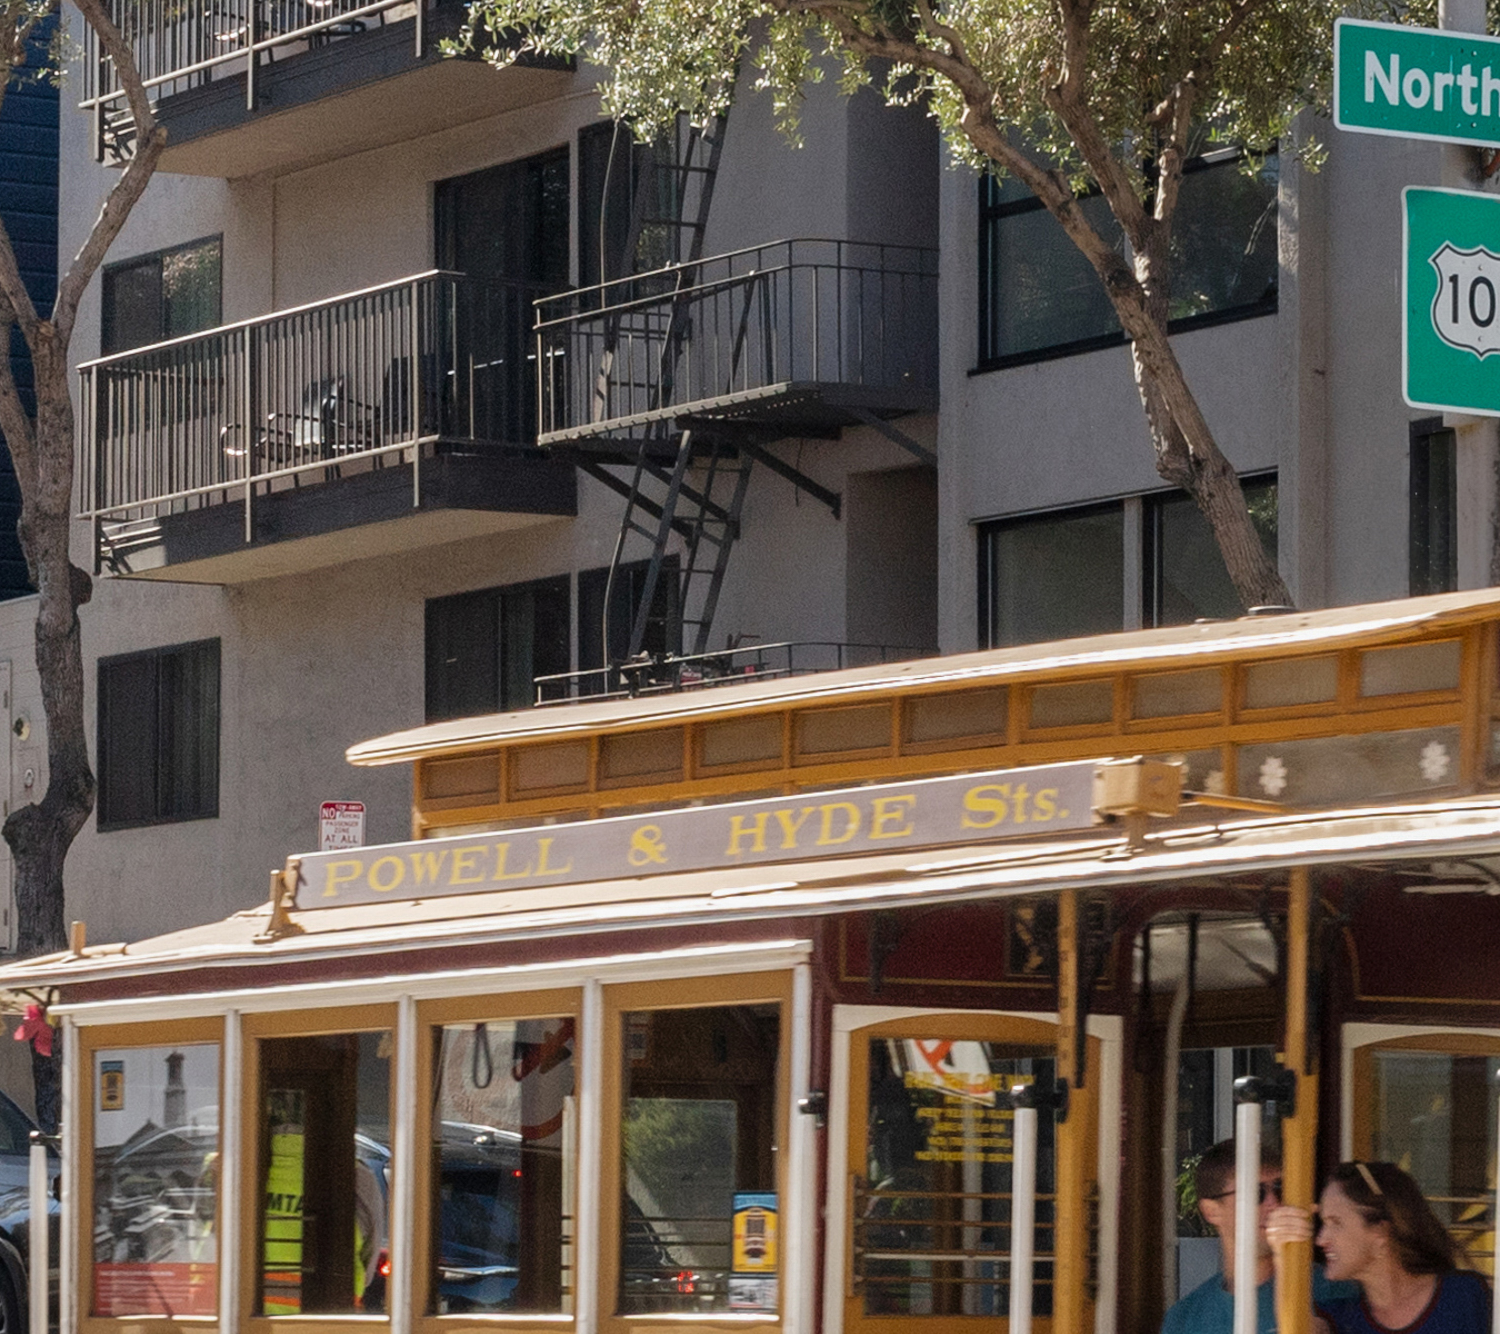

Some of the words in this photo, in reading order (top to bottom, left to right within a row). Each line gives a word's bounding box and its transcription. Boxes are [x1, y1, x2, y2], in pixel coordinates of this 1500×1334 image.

[322, 807, 335, 819] NO
[322, 836, 572, 898] POWELL
[627, 824, 668, 865] &
[727, 793, 915, 855] HYDE
[961, 783, 1070, 830] Sts.
[341, 835, 357, 844] ALL
